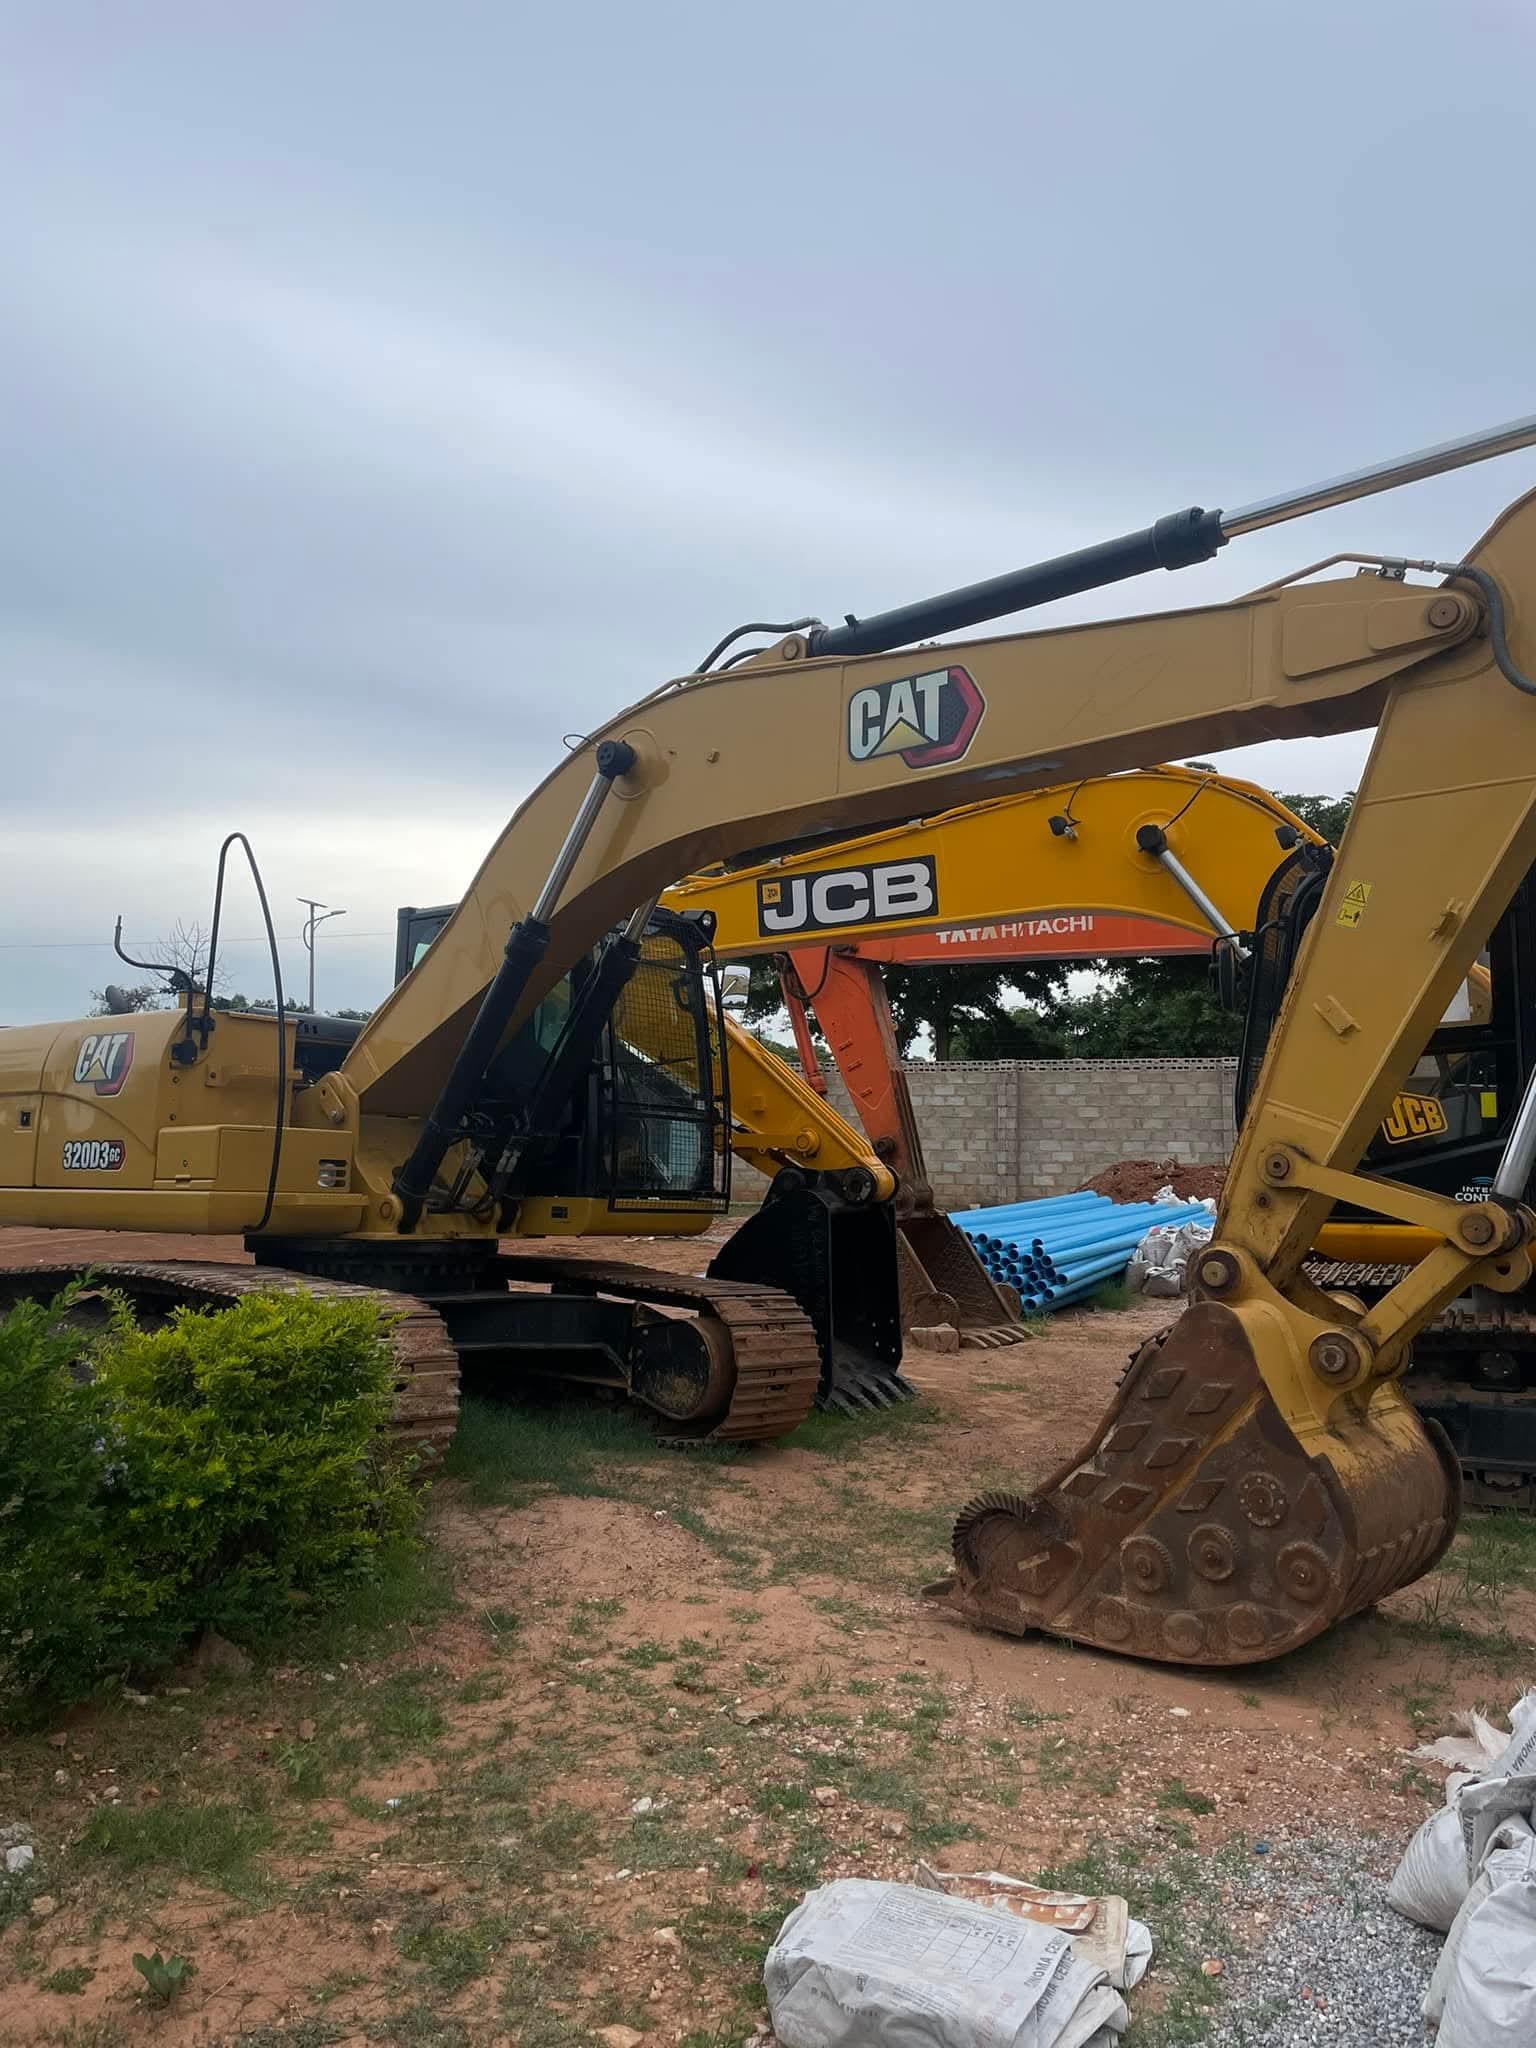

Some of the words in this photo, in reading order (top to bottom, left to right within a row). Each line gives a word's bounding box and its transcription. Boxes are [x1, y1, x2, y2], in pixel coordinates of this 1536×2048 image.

[850, 670, 948, 760] CAT
[763, 863, 933, 930] JCB
[936, 926, 998, 944] TATA
[1001, 915, 1094, 938] HITACHI
[75, 1034, 129, 1081] CAT
[1386, 1096, 1442, 1137] JCB
[63, 1142, 110, 1168] 320D3
[1455, 1193, 1490, 1202] CONT
[1462, 1185, 1492, 1193] INTE
